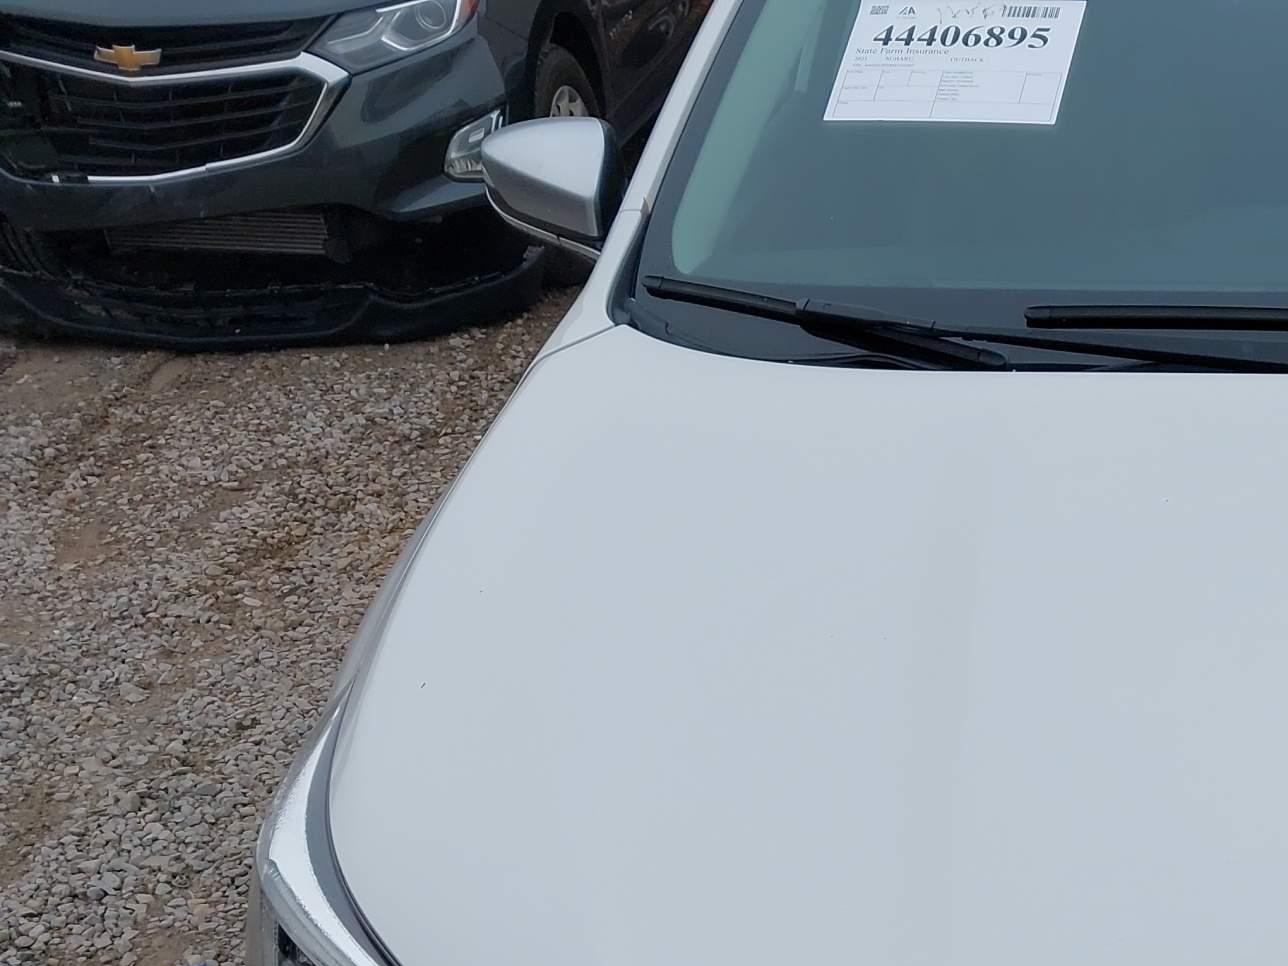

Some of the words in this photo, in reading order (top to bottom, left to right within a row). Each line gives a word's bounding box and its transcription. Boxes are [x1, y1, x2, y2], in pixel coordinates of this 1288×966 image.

[873, 25, 1051, 48] 44406895
[855, 47, 876, 55] State
[879, 47, 904, 55] Farm
[906, 47, 950, 56] Insurance
